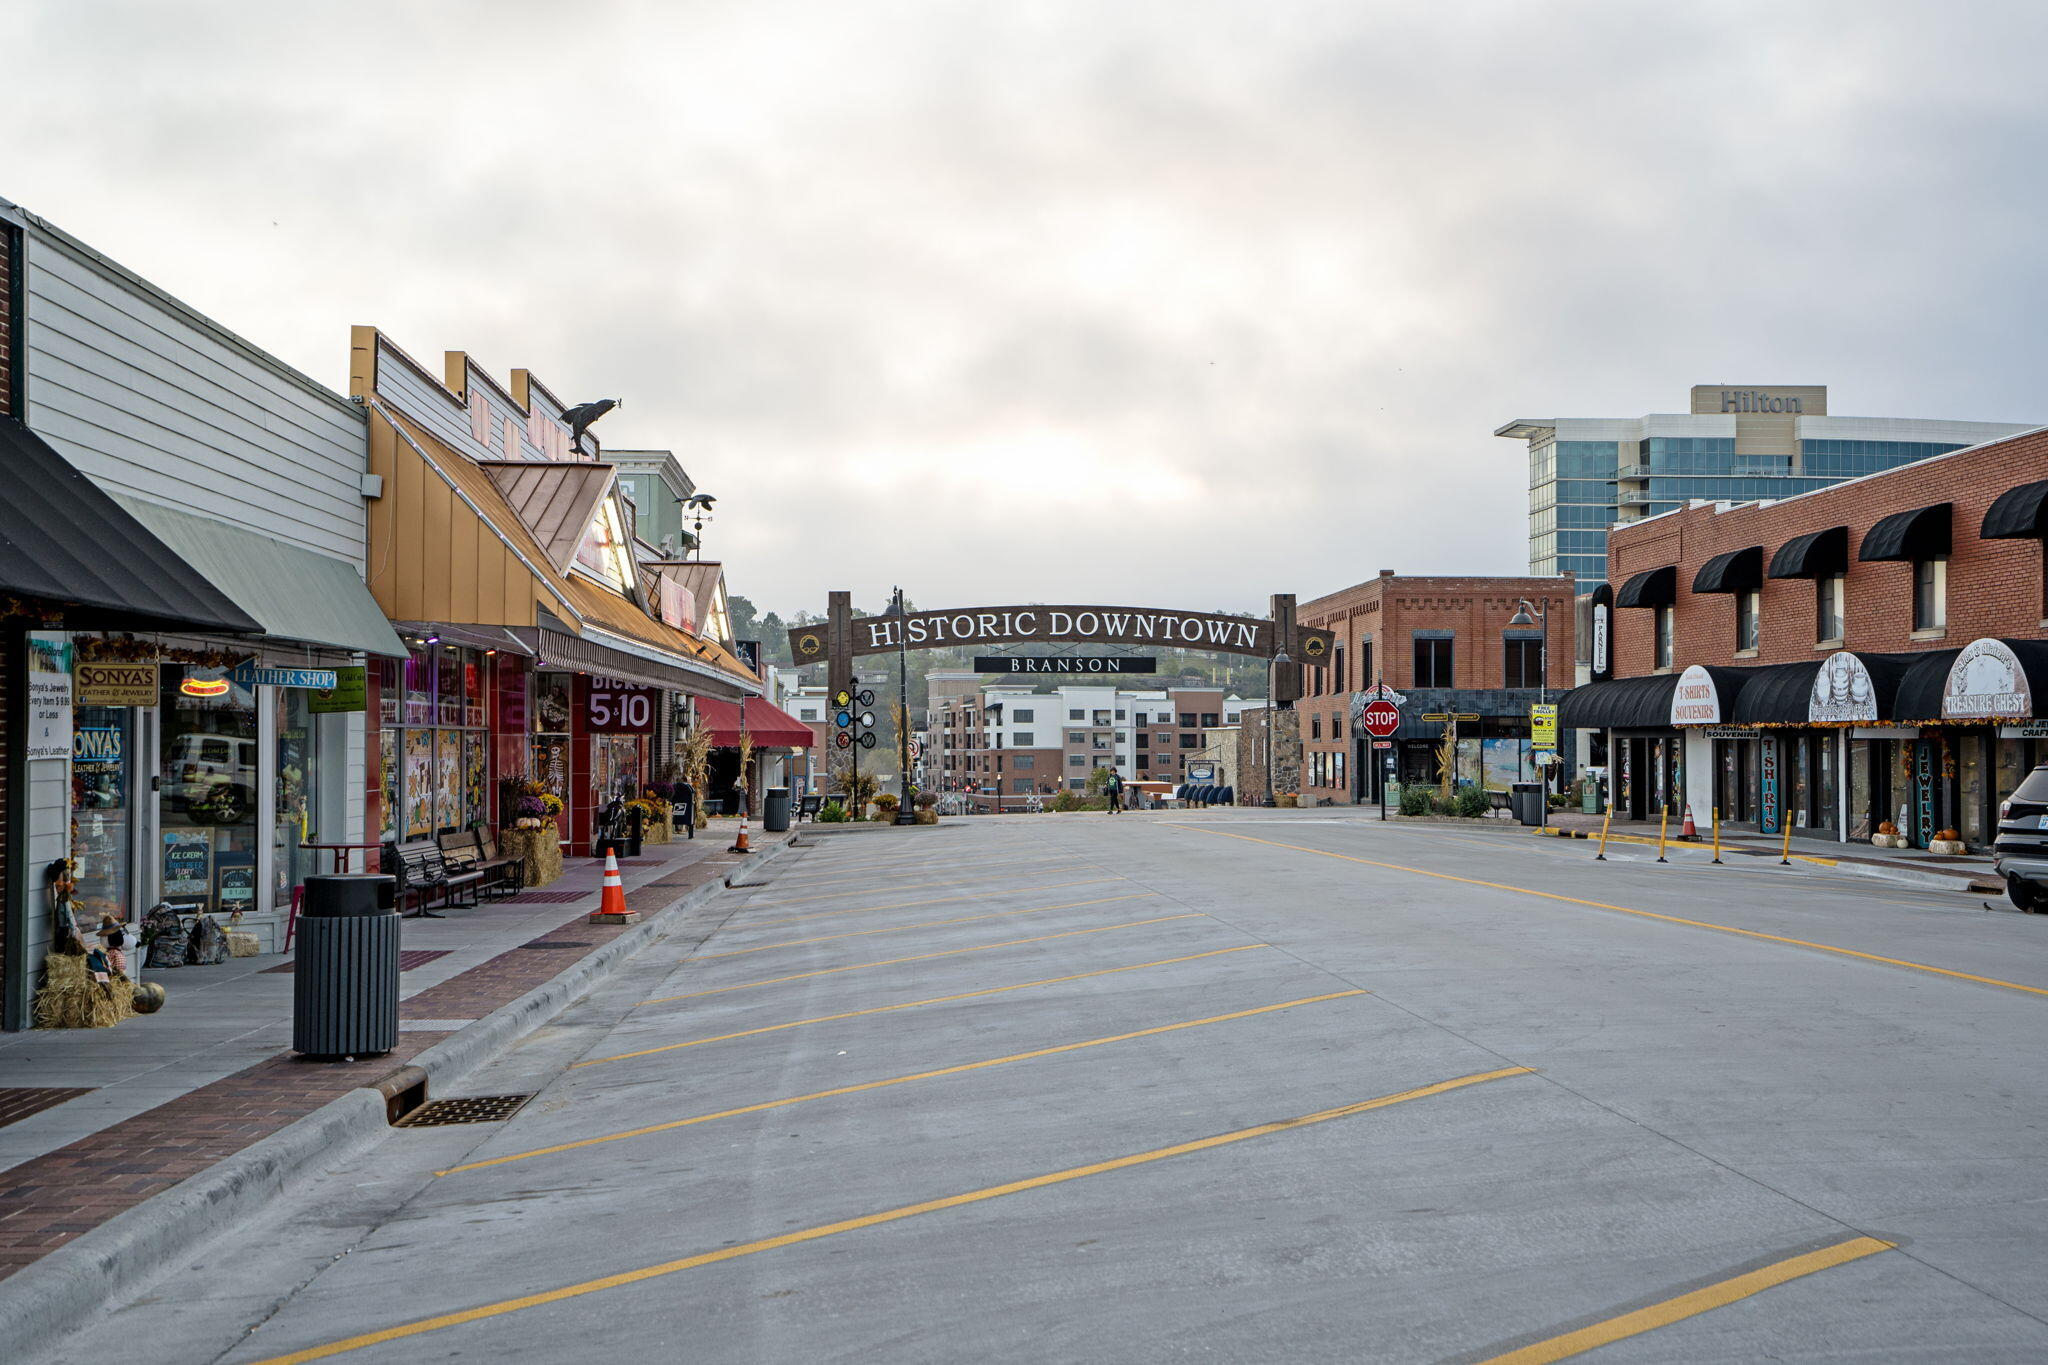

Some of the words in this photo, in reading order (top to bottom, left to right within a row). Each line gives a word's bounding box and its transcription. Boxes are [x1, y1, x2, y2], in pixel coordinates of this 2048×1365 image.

[1720, 391, 1802, 413] Hilton
[868, 612, 1037, 647] HISTORIC
[1049, 612, 1259, 648] DOWNTOWN
[1011, 658, 1120, 672] BRANSON
[80, 667, 153, 686] SONYA'S
[235, 669, 295, 685] LEATHER
[299, 671, 332, 686] SHOP
[592, 676, 648, 690] DICKS
[1679, 684, 1710, 700] T-SHIRTS
[590, 694, 611, 725] 5
[613, 707, 619, 716] &
[619, 694, 649, 726] 10
[1946, 694, 1992, 713] TREASURE
[1993, 693, 2025, 712] CHEST
[46, 709, 58, 719] Less
[1366, 711, 1396, 726] STOP
[1675, 705, 1714, 720] SOUVENIRS
[2035, 720, 2048, 728] JE
[73, 724, 121, 758] ONYA'S
[27, 746, 48, 757] Sonya's
[49, 746, 70, 757] Leather
[1916, 748, 1932, 843] JEWELRY
[183, 851, 203, 859] CREAM
